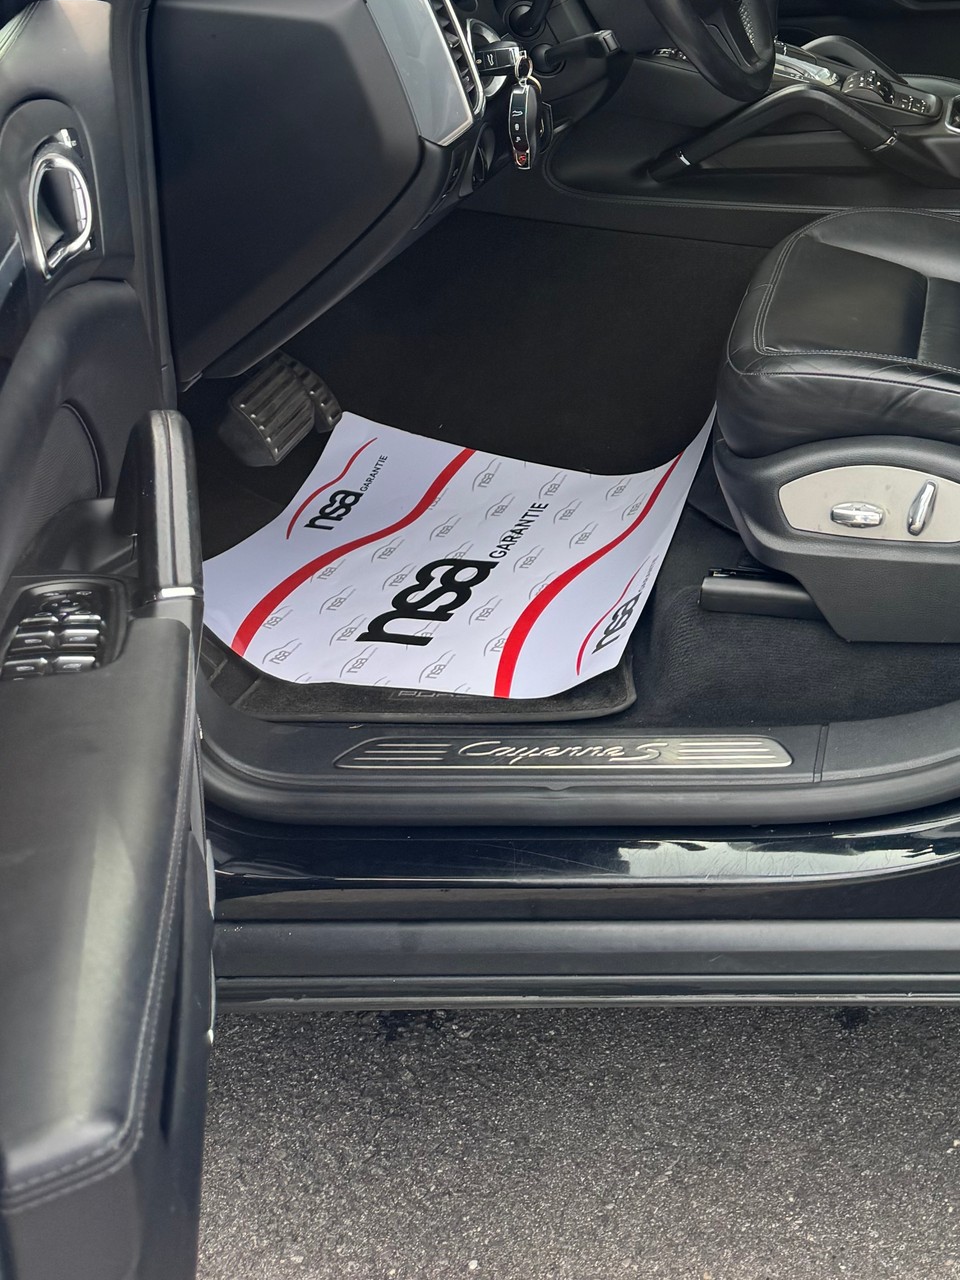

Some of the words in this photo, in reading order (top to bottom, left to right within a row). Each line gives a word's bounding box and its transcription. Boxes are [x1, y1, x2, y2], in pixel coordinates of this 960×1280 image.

[303, 489, 364, 531] nsa
[360, 454, 388, 492] GARANTIE
[355, 558, 499, 646] nsa
[488, 502, 549, 559] GARANTIE
[591, 592, 642, 654] nsa
[458, 740, 625, 765] Cayenne
[608, 742, 669, 762] S
